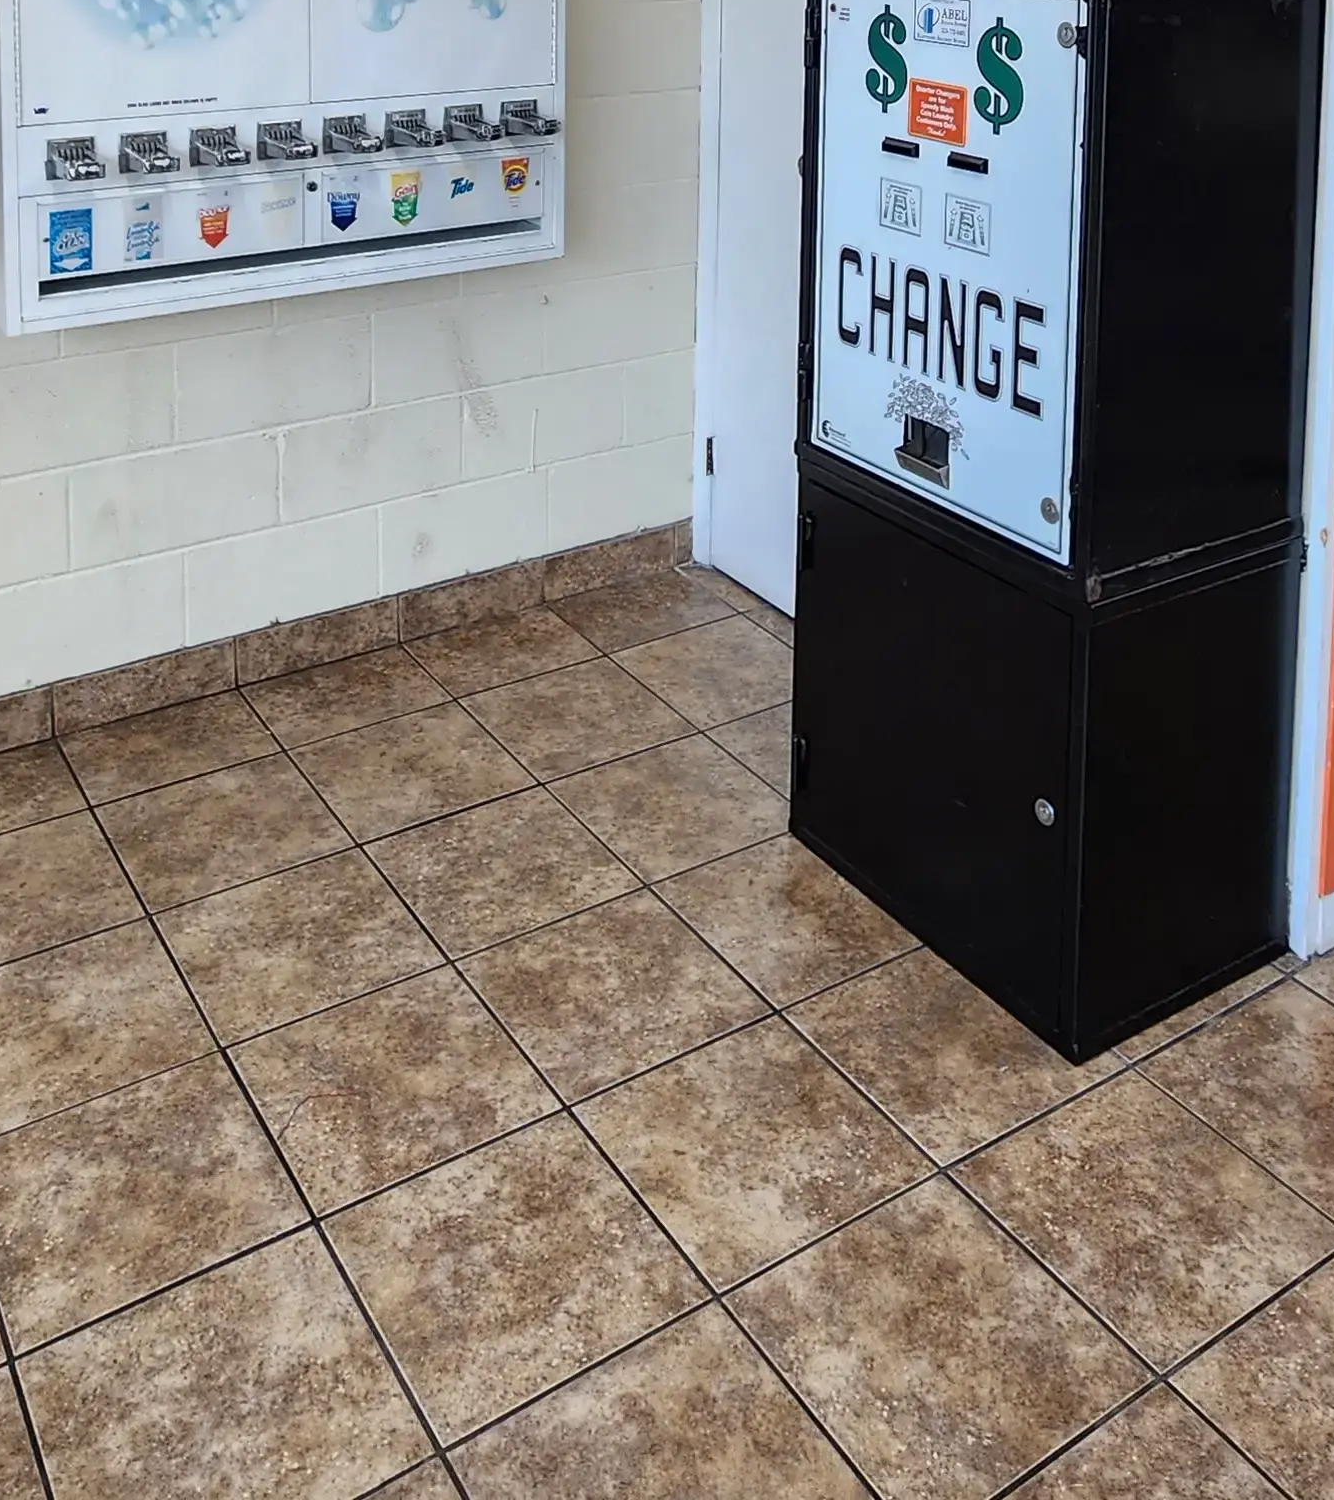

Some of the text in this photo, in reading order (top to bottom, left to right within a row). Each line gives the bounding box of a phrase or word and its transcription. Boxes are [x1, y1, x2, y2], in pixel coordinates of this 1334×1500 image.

[941, 8, 968, 21] ABEL
[450, 177, 475, 199] Tide
[504, 173, 527, 191] Tide
[838, 244, 1047, 421] CHANGE
